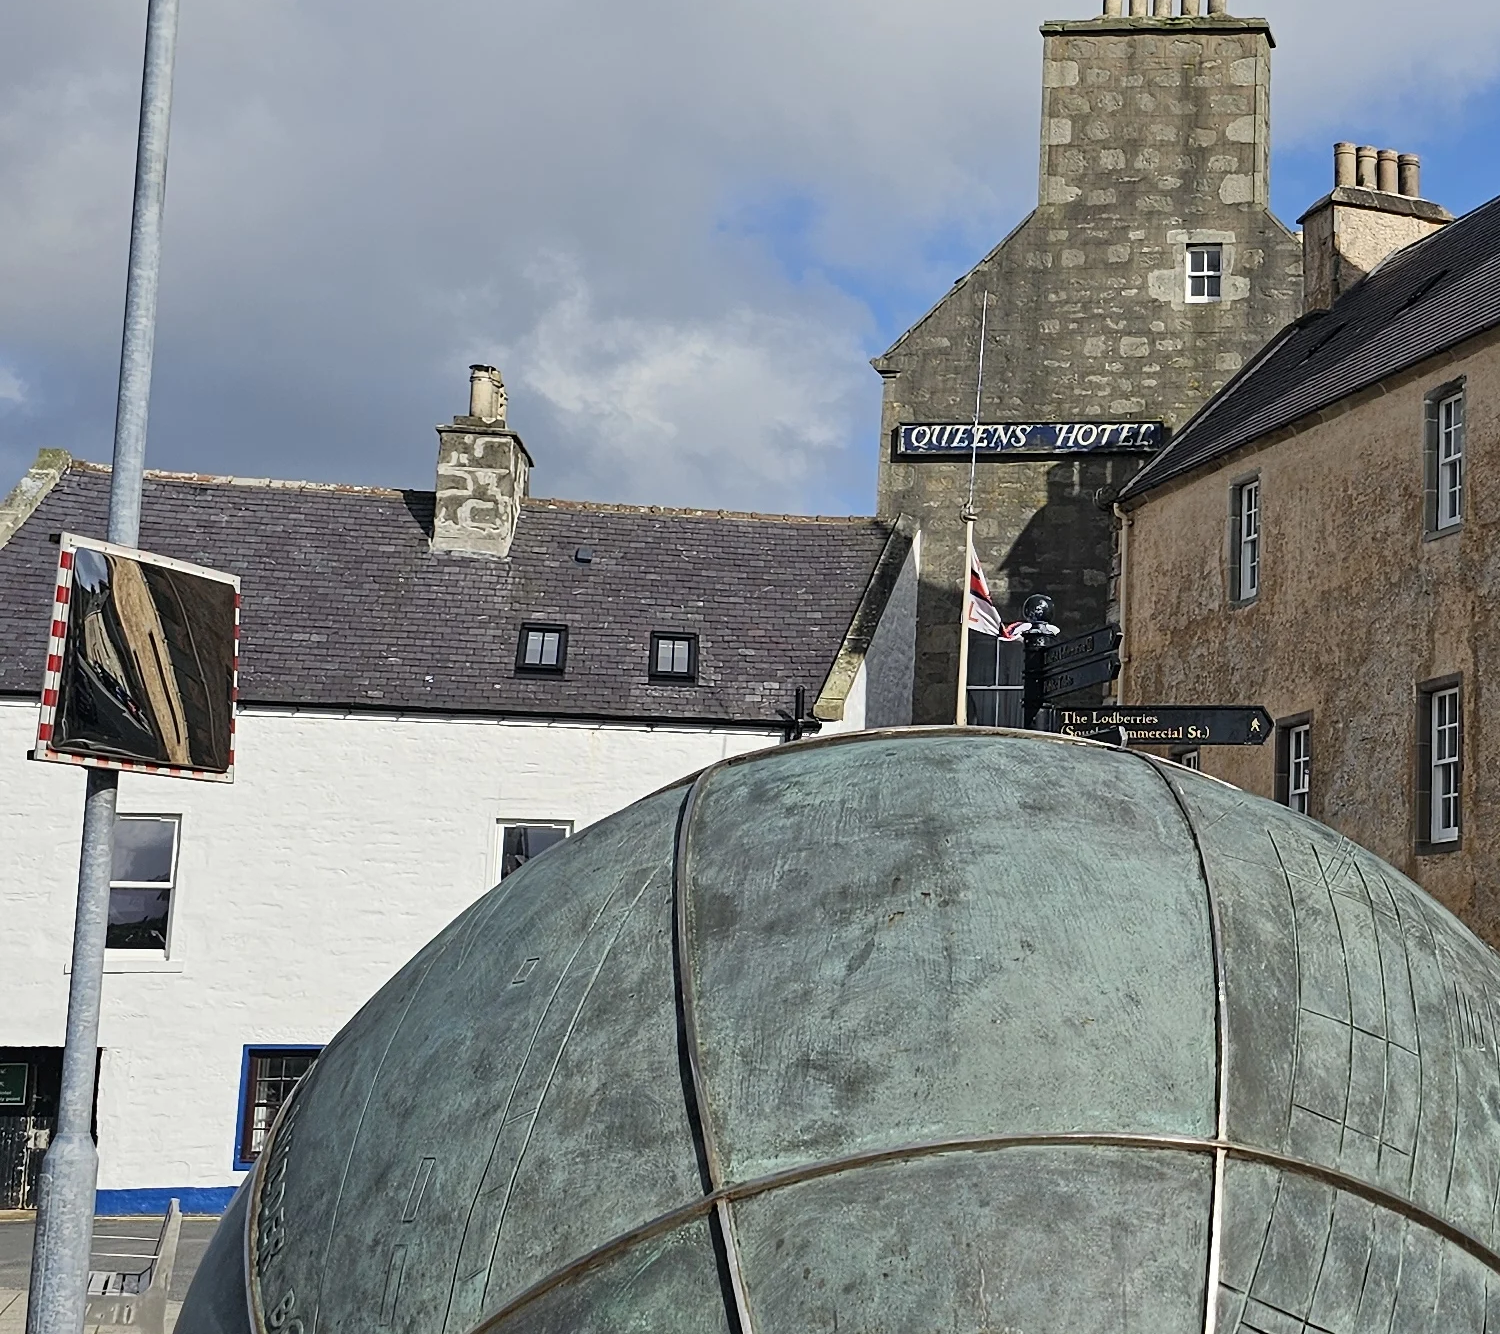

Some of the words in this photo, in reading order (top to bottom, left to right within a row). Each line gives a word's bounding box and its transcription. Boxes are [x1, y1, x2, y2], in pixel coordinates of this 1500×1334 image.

[910, 424, 1033, 449] QUEENS
[1050, 423, 1155, 447] HOTEL
[1060, 711, 1088, 724] The
[1092, 711, 1159, 724] Lodberries
[1187, 725, 1210, 740] St.)
